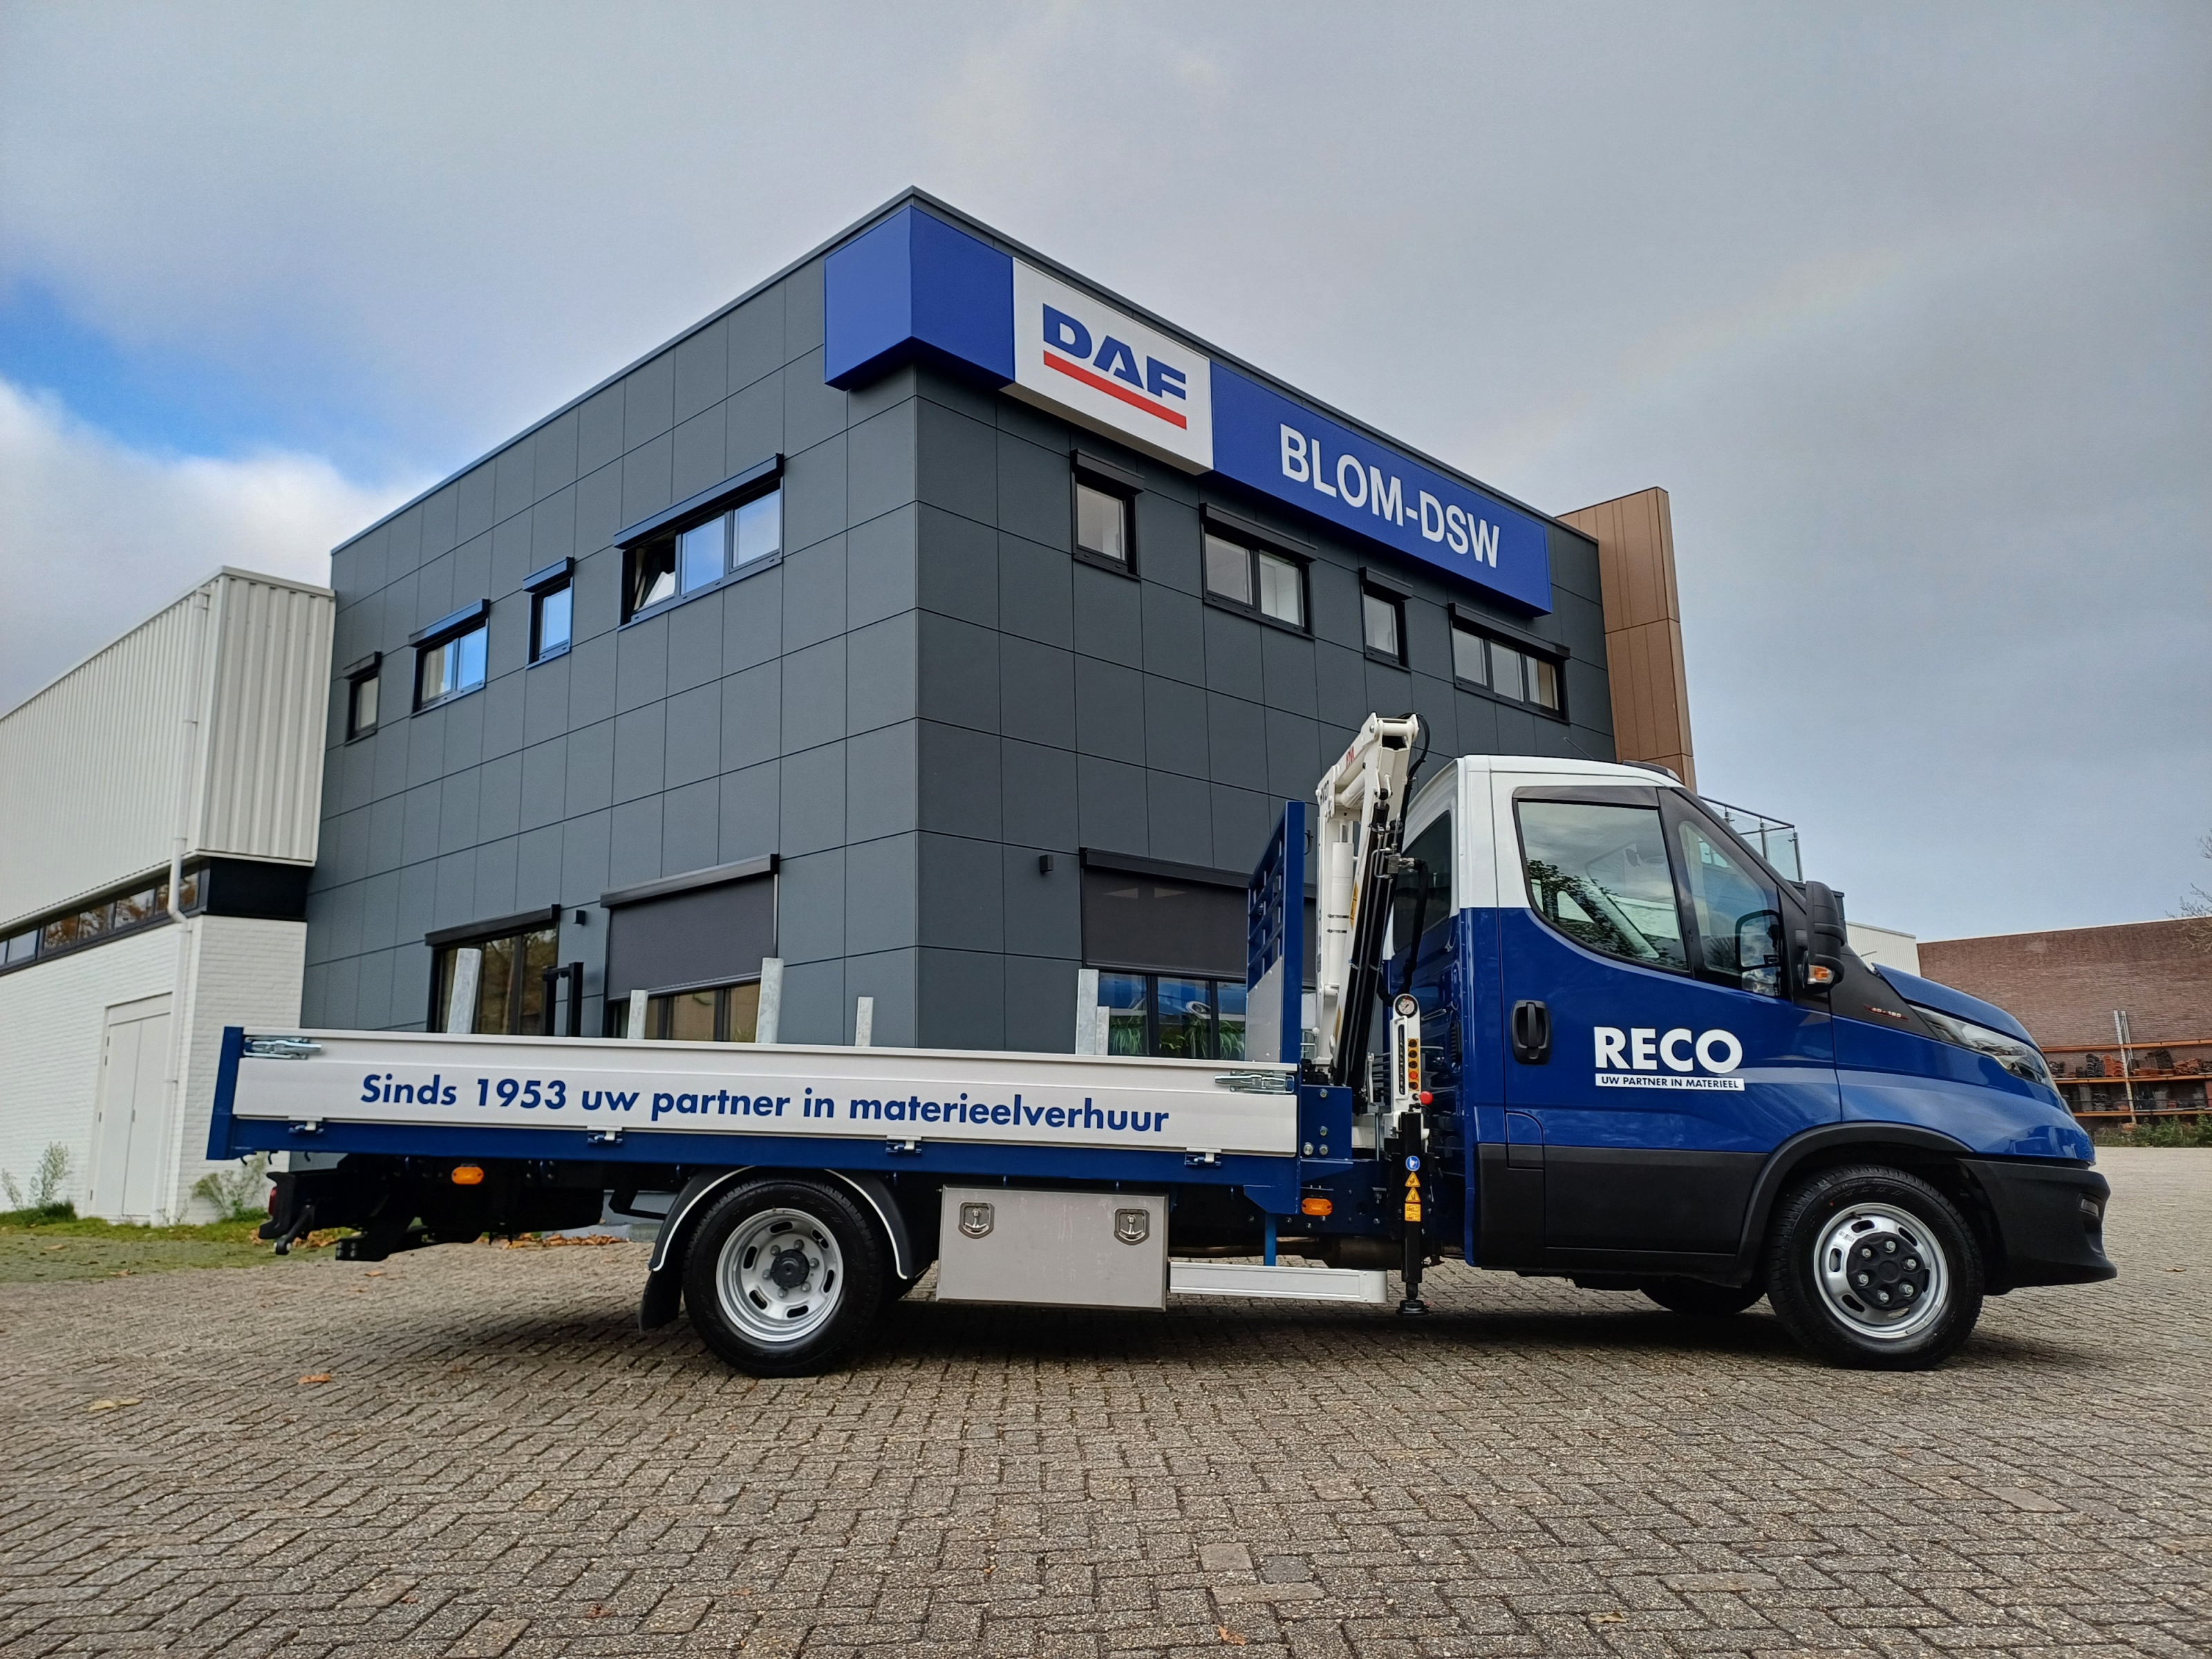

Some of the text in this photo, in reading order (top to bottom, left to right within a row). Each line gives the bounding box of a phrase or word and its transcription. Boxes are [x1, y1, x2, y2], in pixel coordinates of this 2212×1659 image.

[1042, 303, 1186, 400] DAF
[1280, 423, 1500, 568] BLOM-DSW
[1594, 1027, 1742, 1073] RECO
[361, 1074, 1169, 1132] Sinds 1953 uw partner in materieelverhuur
[1601, 1076, 1738, 1088] UW PARTNER IN MATERIEEL
